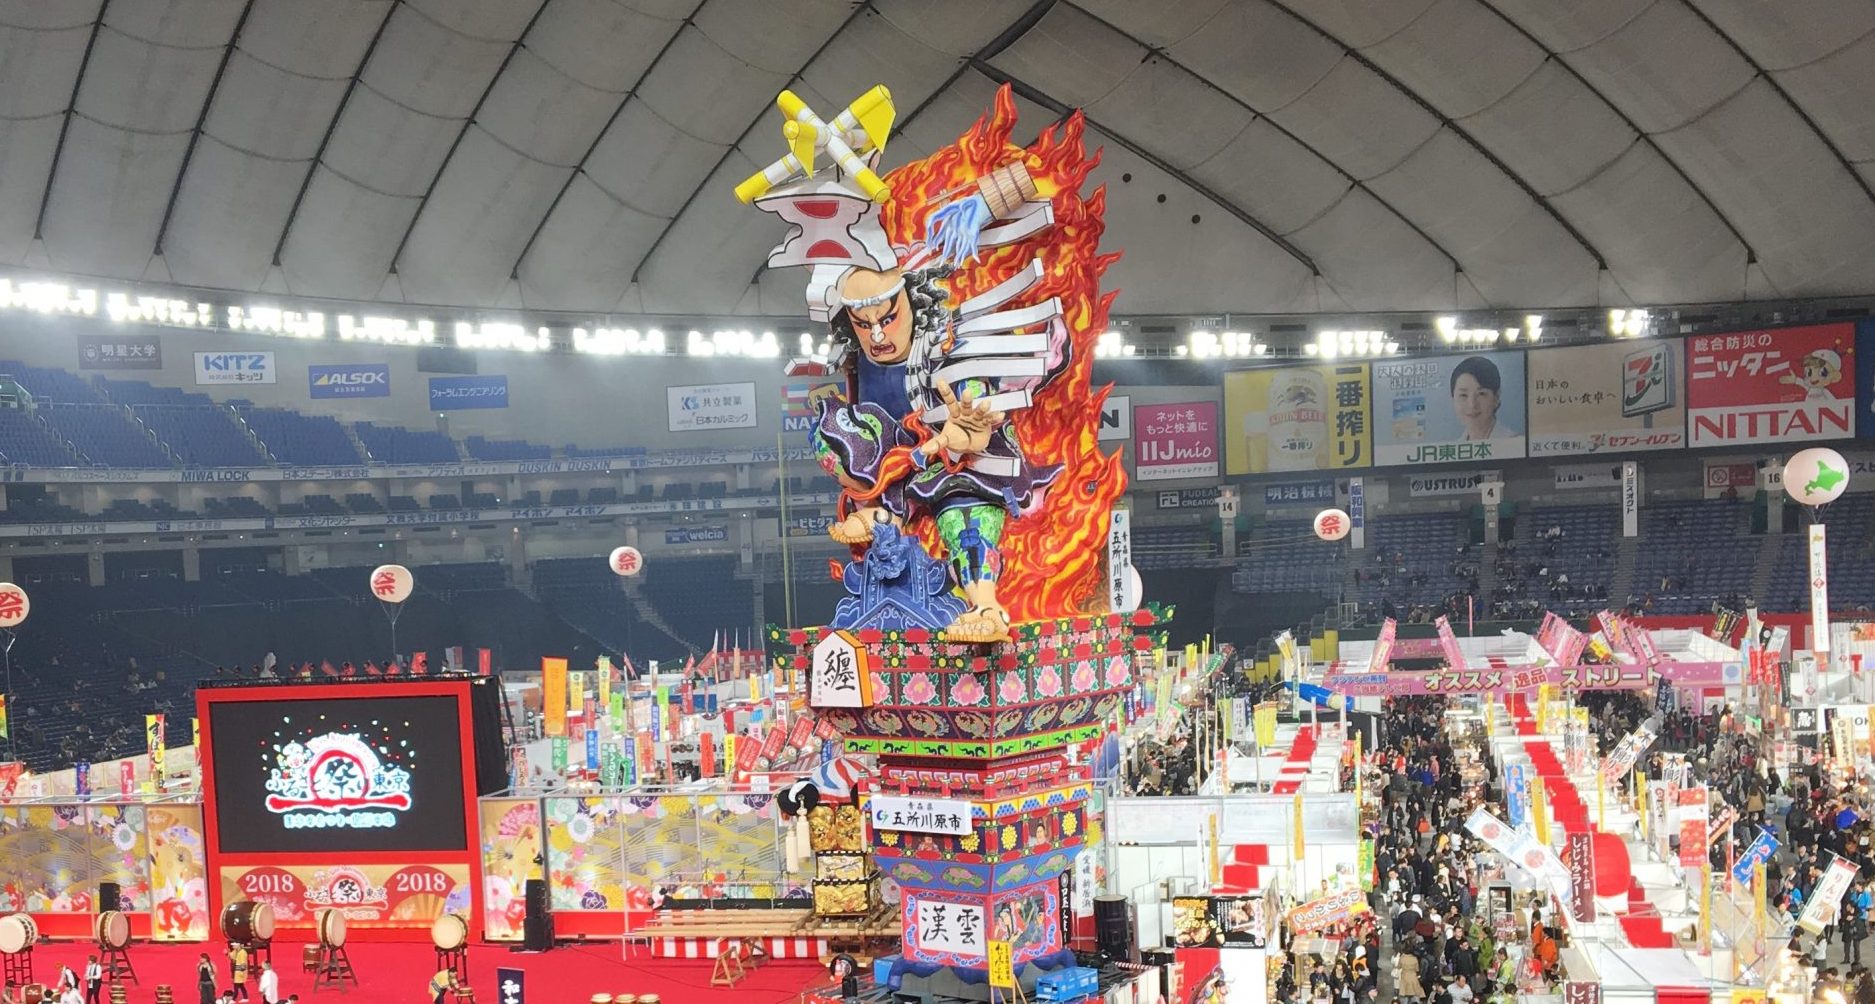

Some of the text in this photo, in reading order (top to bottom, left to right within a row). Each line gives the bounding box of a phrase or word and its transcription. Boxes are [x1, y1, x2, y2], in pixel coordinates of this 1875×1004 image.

[101, 343, 156, 358] 明星大学
[1694, 334, 1772, 352] 総合防災の
[204, 354, 265, 371] KITZ
[1693, 350, 1790, 379] ニッタン
[328, 372, 385, 385] ALSOK
[1536, 379, 1569, 390] 日本の
[1157, 410, 1195, 422] ネットを
[1336, 366, 1363, 466] 一番搾り
[1694, 405, 1849, 441] NITTAN
[1146, 422, 1208, 434] もっと快適に
[1407, 442, 1492, 462] JR東日本
[181, 471, 249, 482] MIWA LOCK
[518, 462, 561, 473] DUSKIN
[1768, 473, 1781, 484] 16
[512, 506, 607, 518] アイホン アイホン
[1222, 502, 1233, 512] 14
[1320, 515, 1341, 535] 祭
[1112, 531, 1124, 609] 五所川原市
[374, 572, 396, 596] 祭
[824, 647, 856, 691] 纏
[1424, 664, 1664, 691] オススメ 逸品 ストリート
[892, 811, 962, 831] 五所川原市
[246, 874, 294, 892] 2018
[397, 872, 446, 892] 2018
[1572, 836, 1585, 919] しじみラーメン
